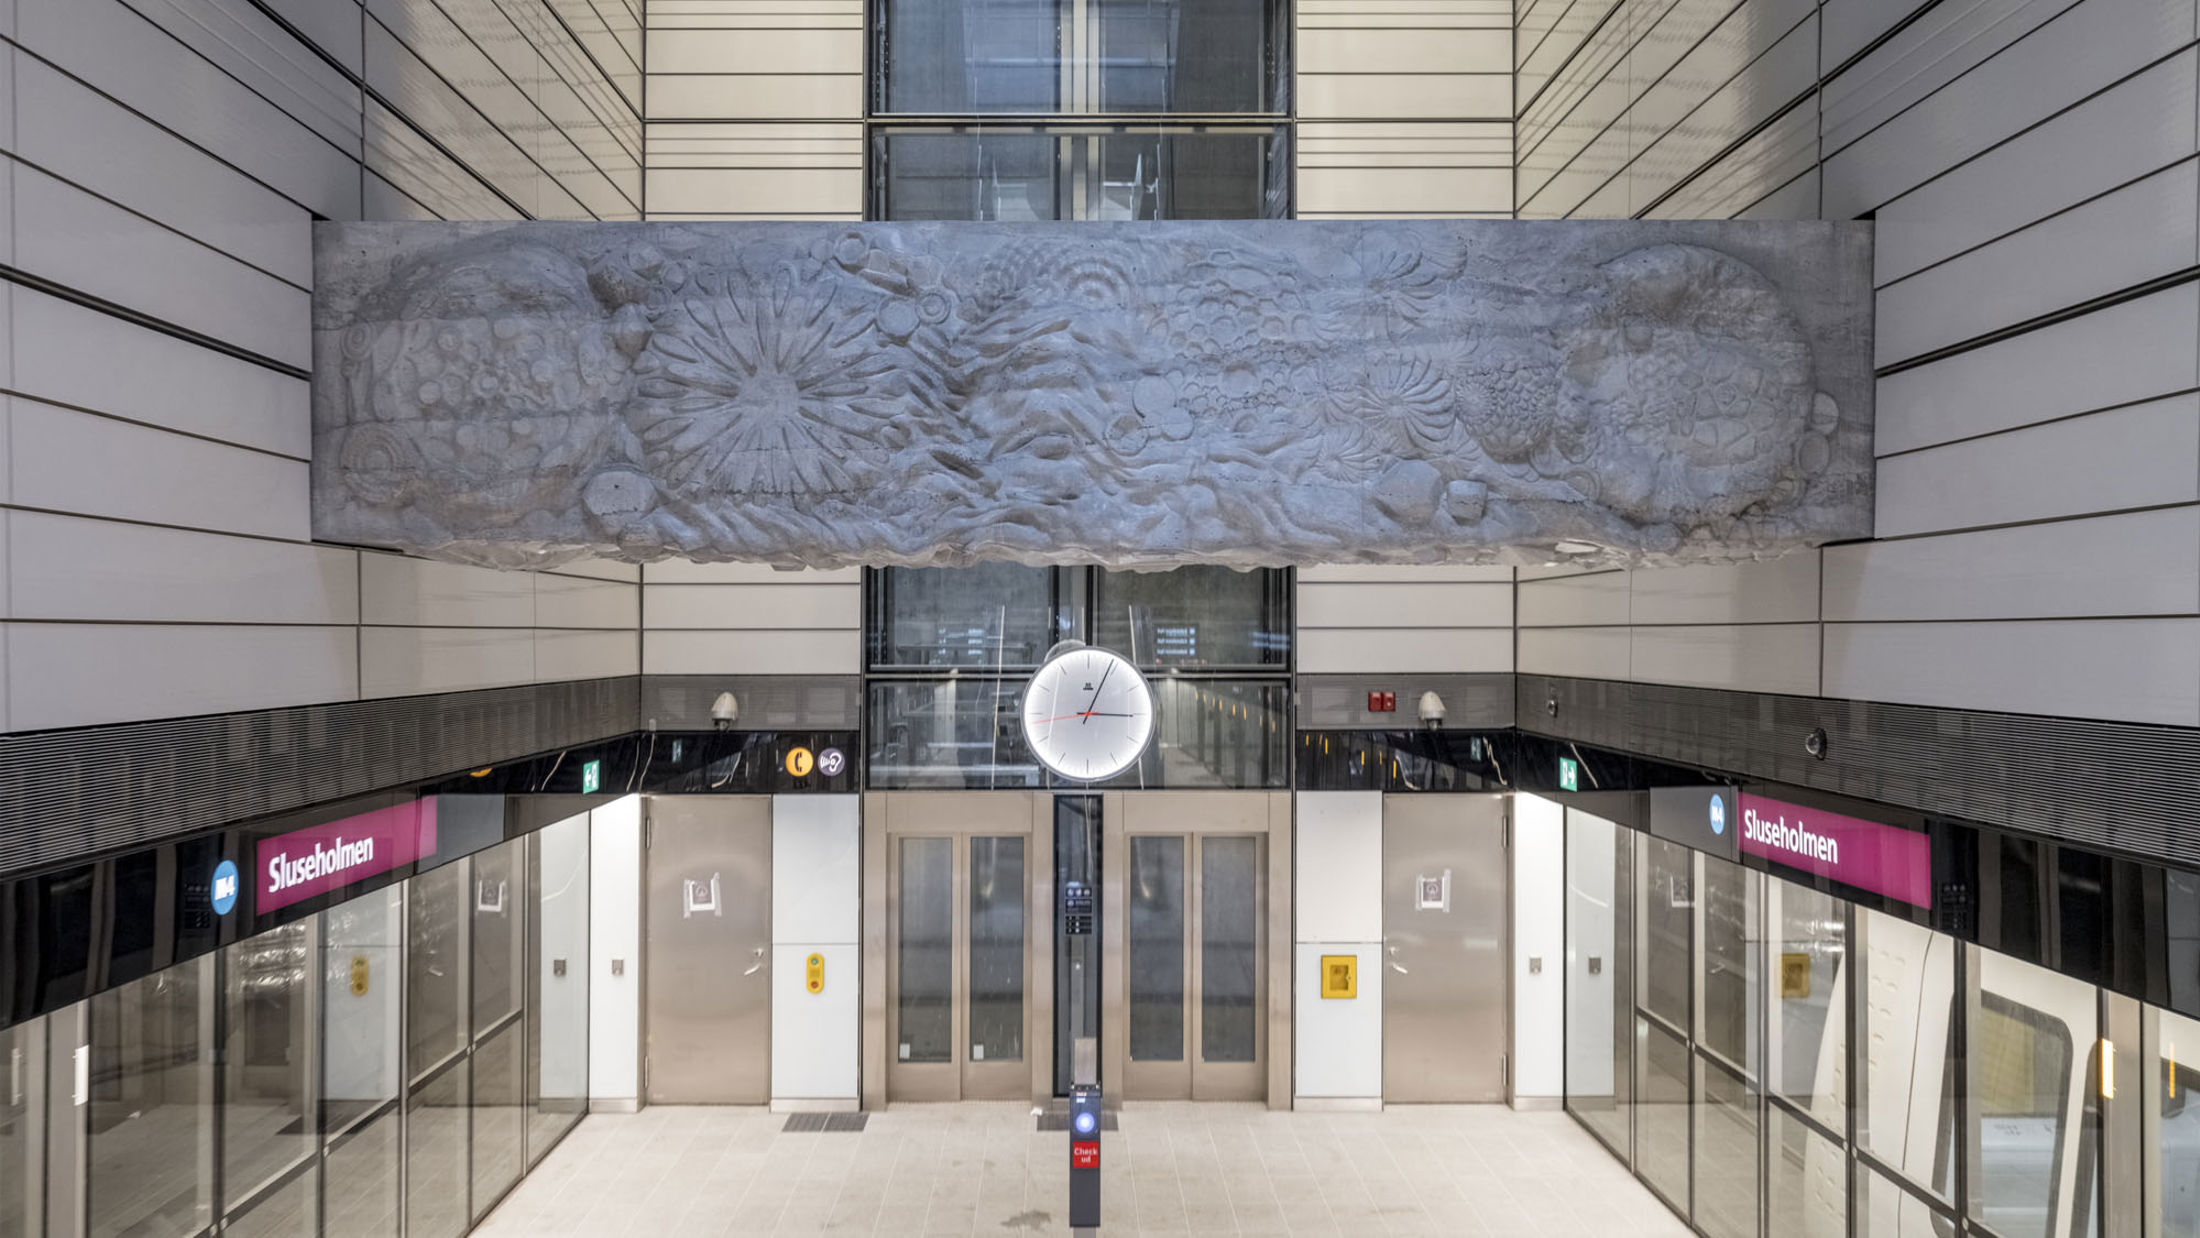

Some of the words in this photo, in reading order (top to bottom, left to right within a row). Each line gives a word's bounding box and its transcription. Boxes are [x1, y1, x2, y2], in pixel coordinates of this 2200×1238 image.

[1744, 808, 1838, 864] Sluseholmen
[268, 836, 374, 893] Sluseholmen
[1074, 1147, 1097, 1156] Check
